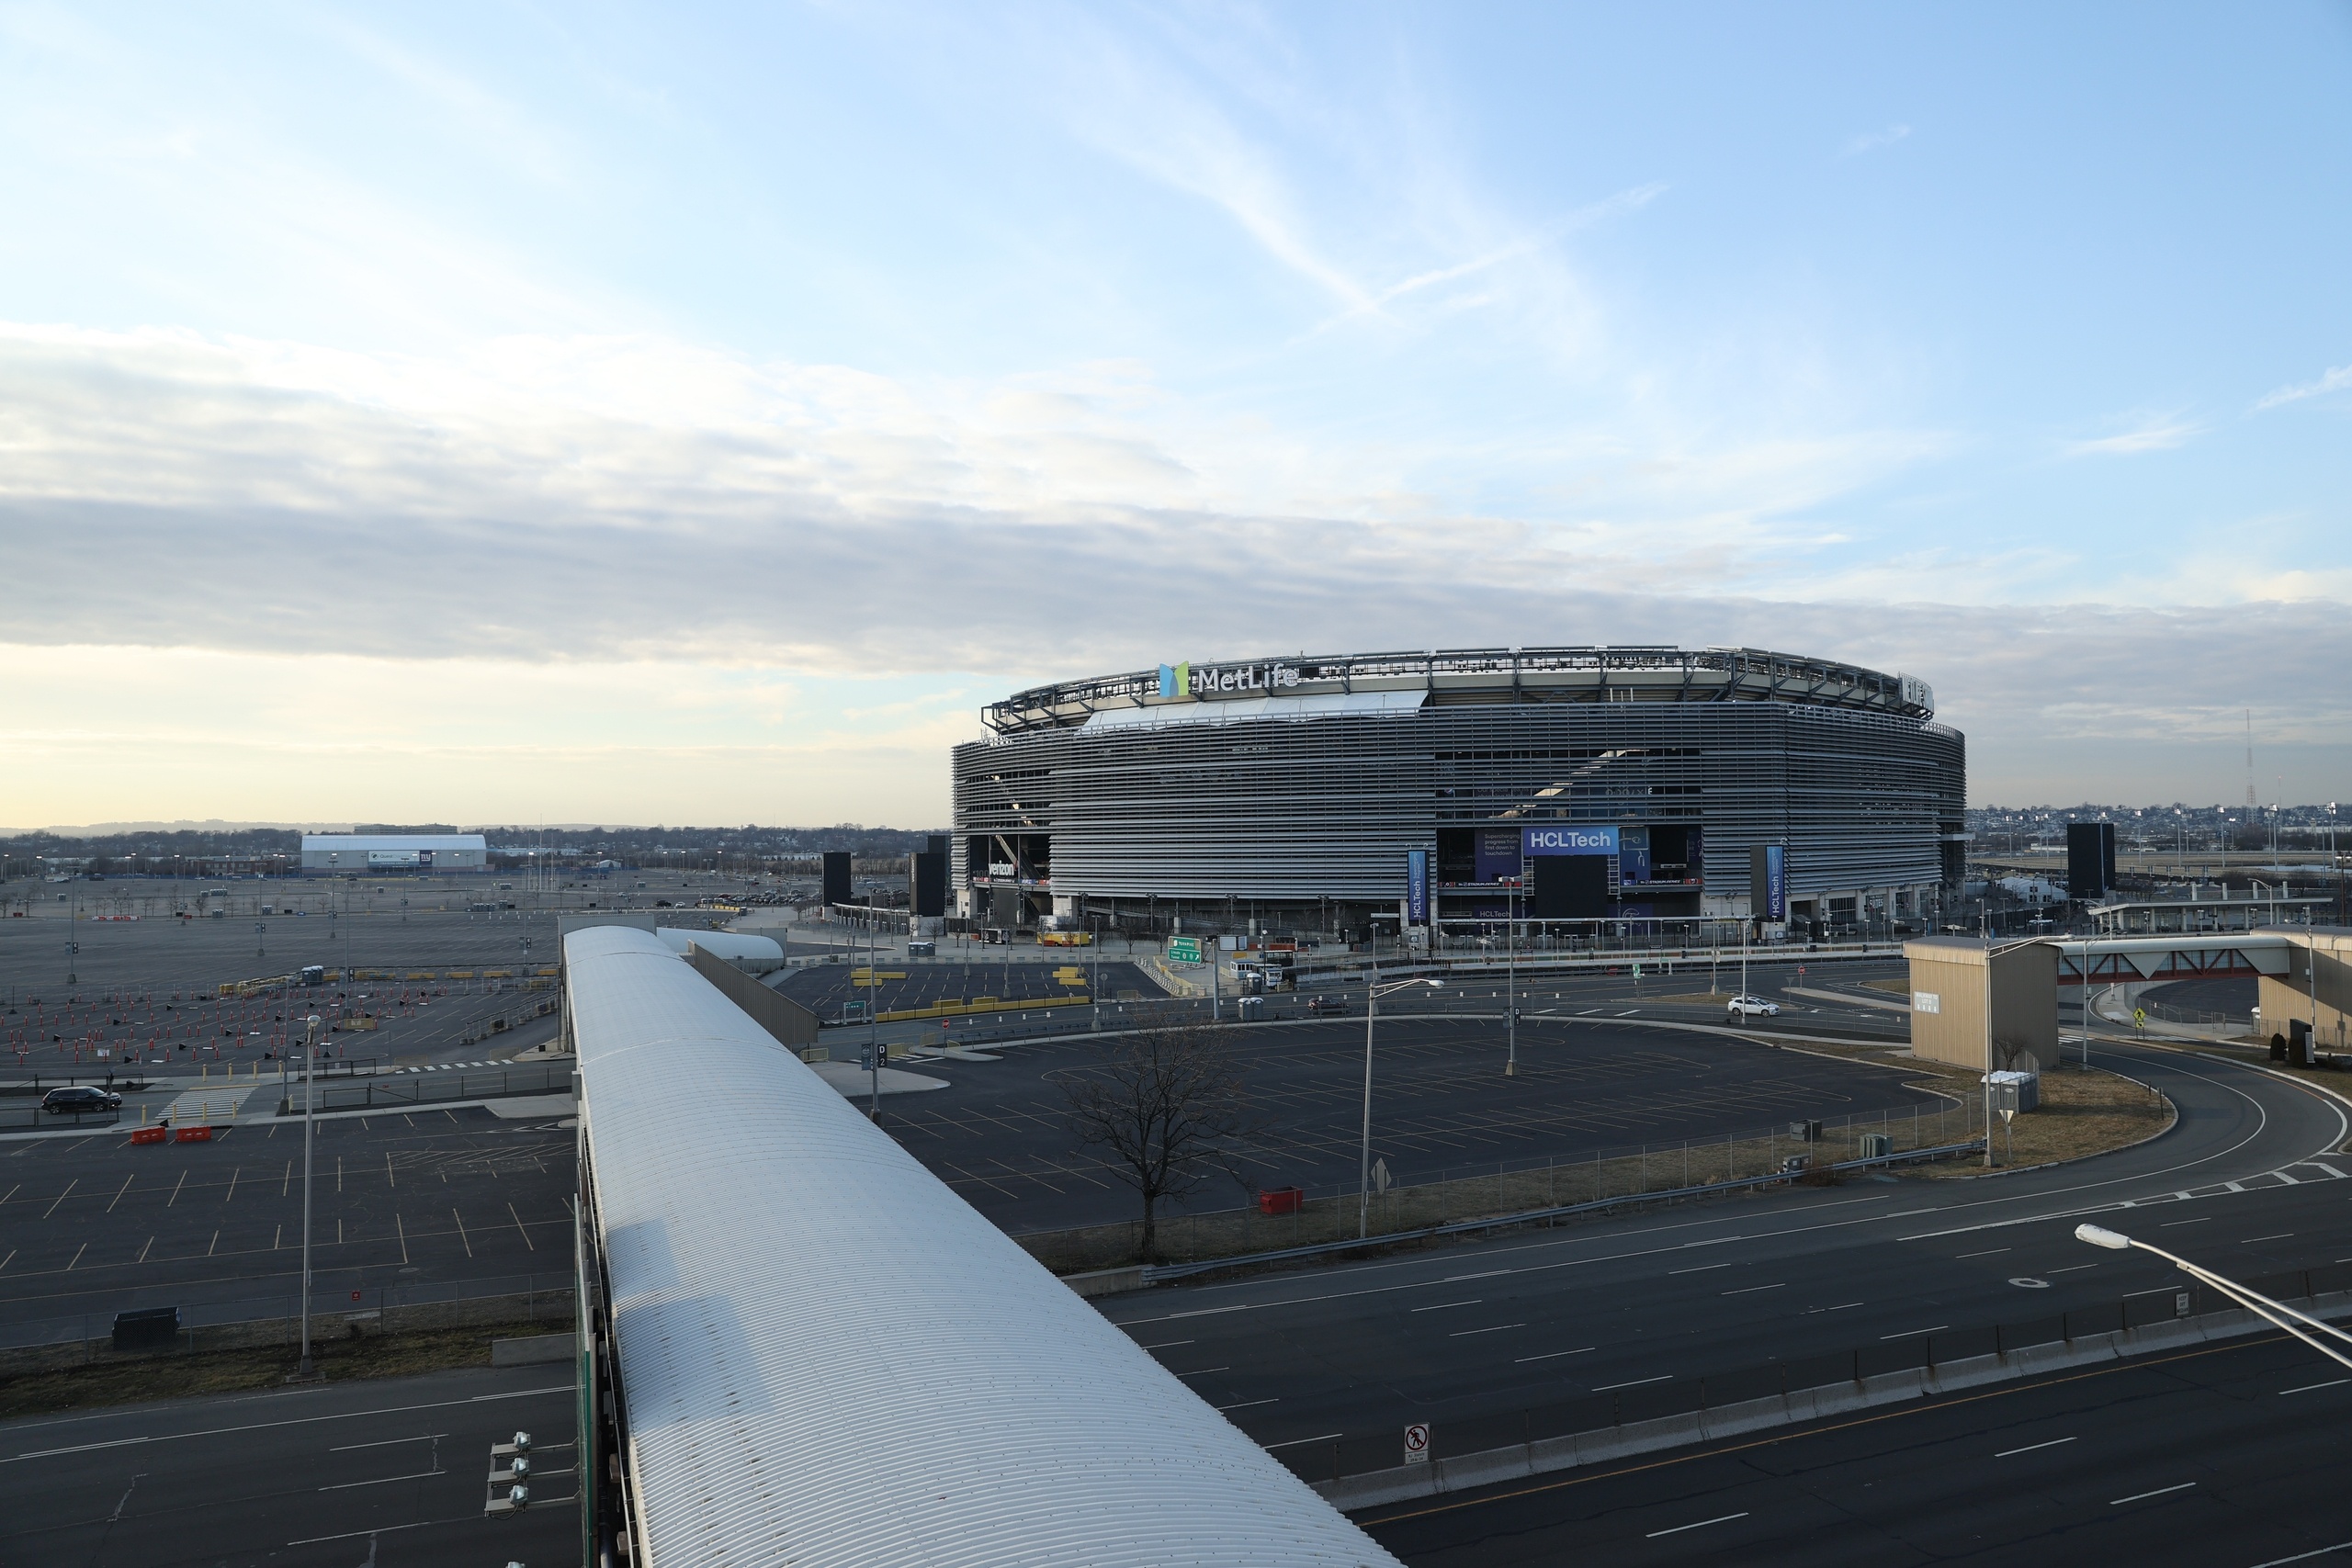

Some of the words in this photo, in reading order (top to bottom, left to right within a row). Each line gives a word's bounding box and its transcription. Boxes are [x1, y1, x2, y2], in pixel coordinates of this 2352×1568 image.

[1198, 663, 1300, 692] MetLife
[1531, 831, 1611, 848] HCLTech
[989, 860, 1014, 875] verizon
[1413, 881, 1421, 918] HCLTech
[1771, 875, 1780, 913] HCLTech
[879, 1045, 885, 1054] D
